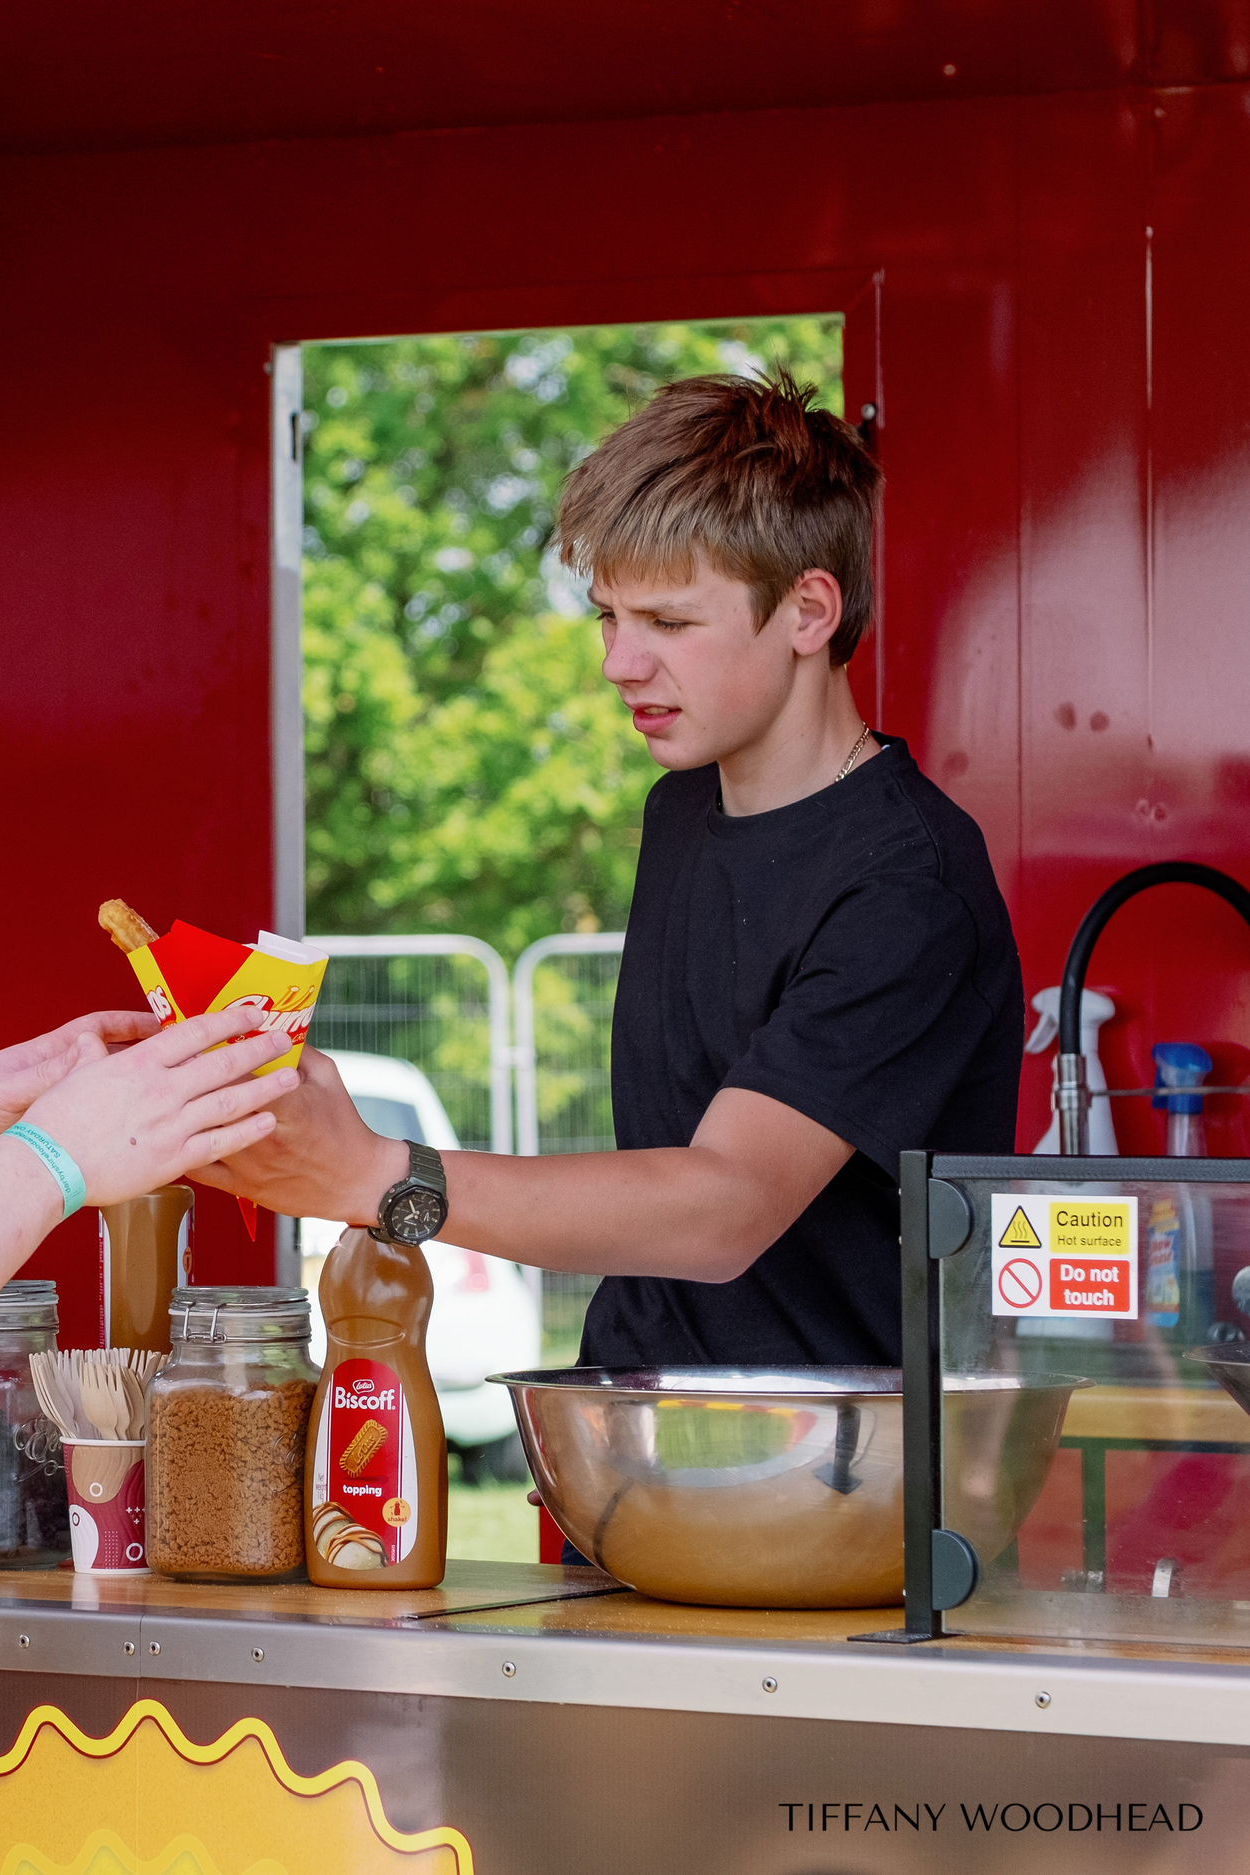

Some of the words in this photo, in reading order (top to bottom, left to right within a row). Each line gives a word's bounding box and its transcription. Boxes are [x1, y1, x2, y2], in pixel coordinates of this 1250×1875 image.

[1056, 1210, 1124, 1228] Caution
[1057, 1234, 1078, 1246] Hot
[1080, 1235, 1122, 1247] surface
[1060, 1264, 1086, 1282] Do
[1089, 1266, 1120, 1283] not
[1063, 1288, 1115, 1306] touch
[334, 1386, 395, 1410] Biscoff
[342, 1484, 382, 1497] topping
